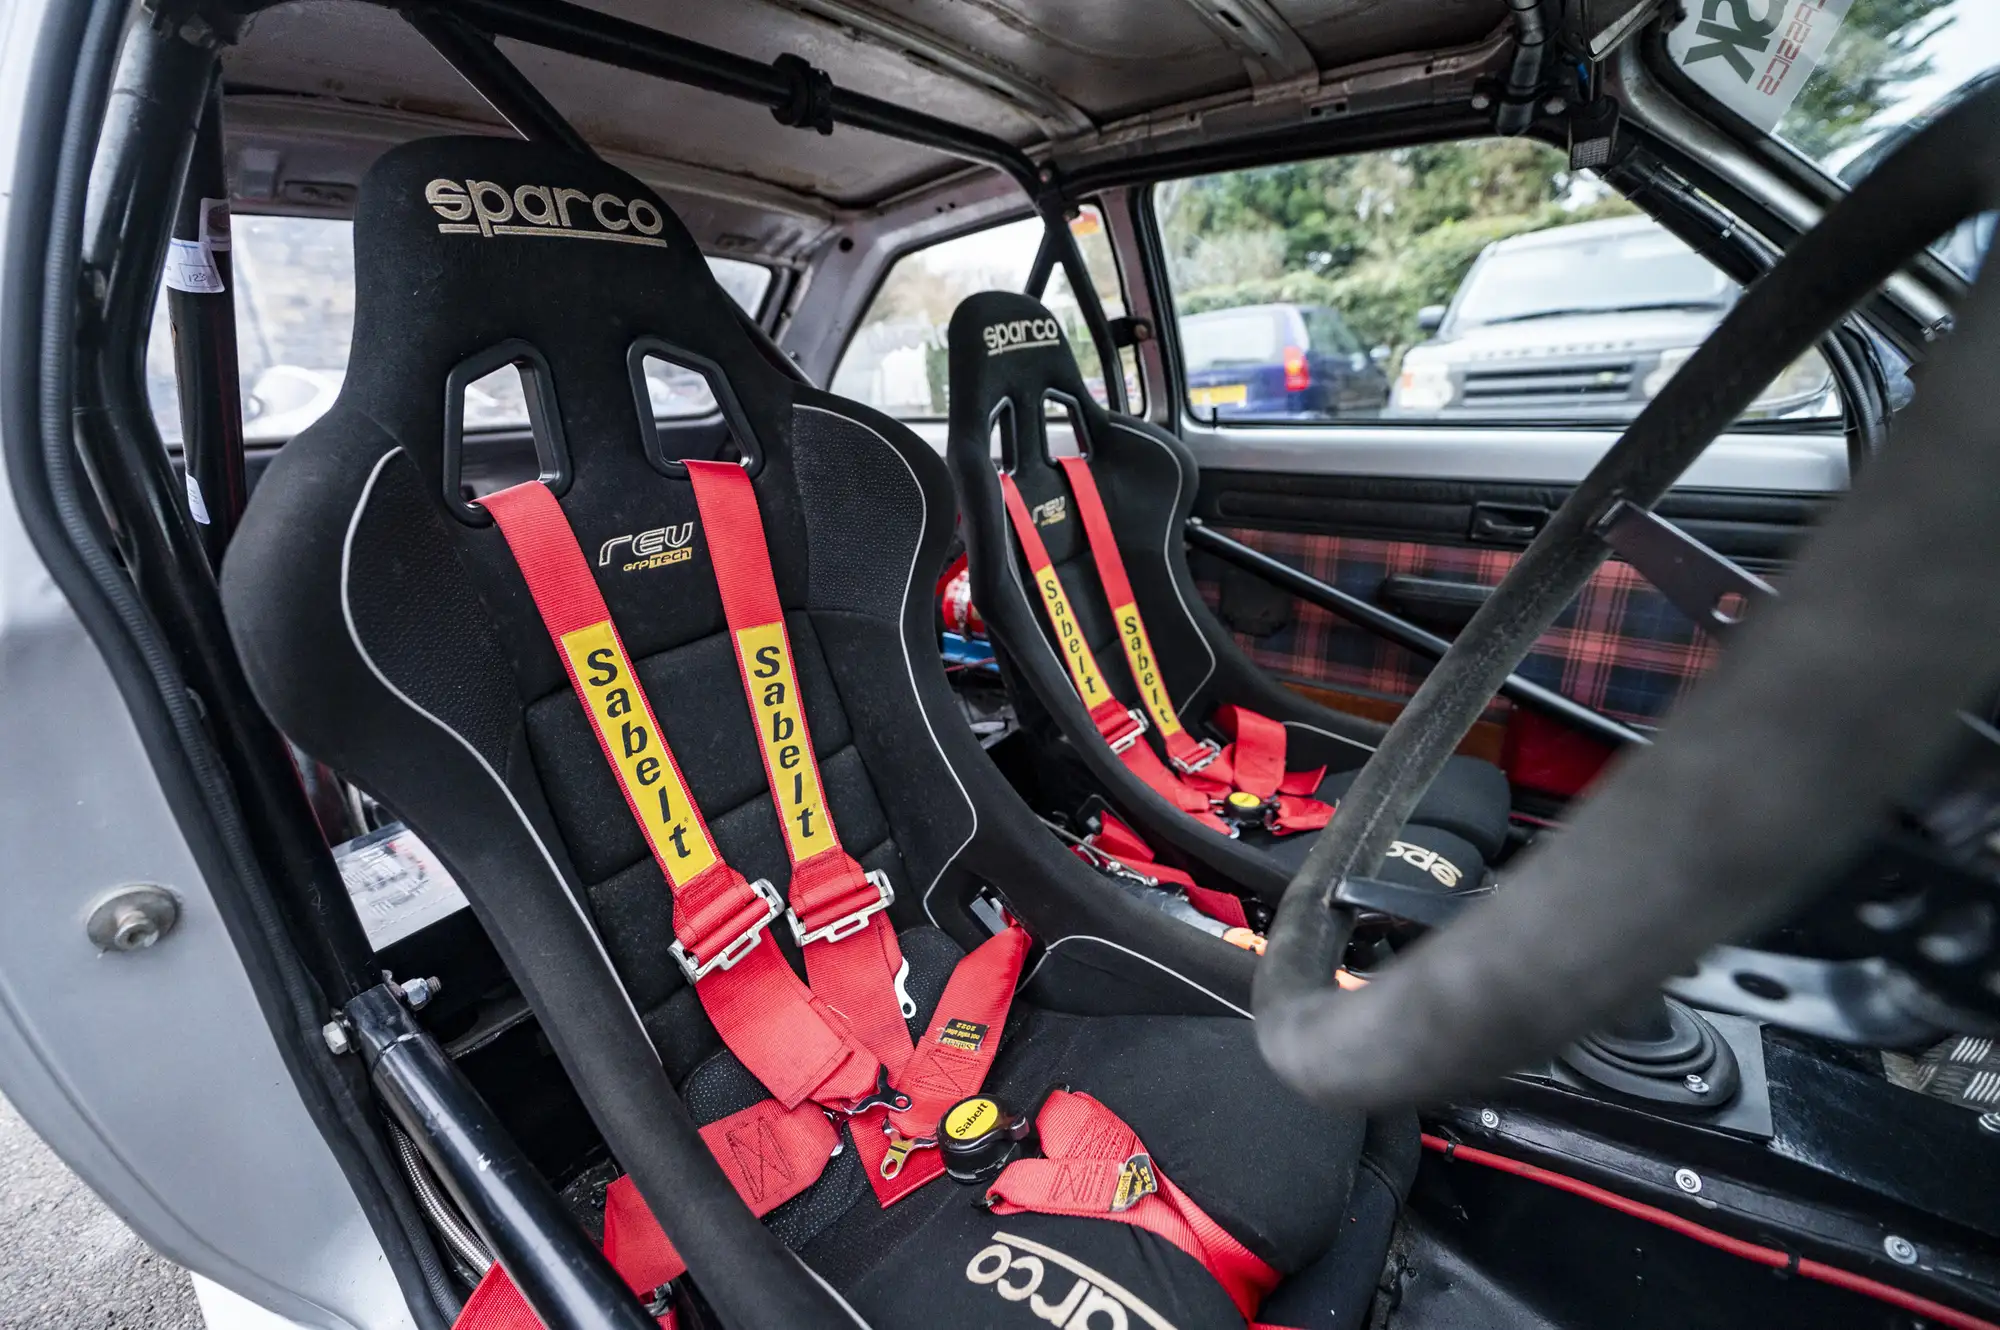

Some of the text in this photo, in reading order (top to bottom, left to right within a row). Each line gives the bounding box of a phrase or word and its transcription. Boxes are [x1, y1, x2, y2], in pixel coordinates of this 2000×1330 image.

[425, 178, 665, 240] sparco
[983, 318, 1059, 355] sparco
[1045, 580, 1097, 693] Sabelt
[1124, 616, 1170, 723] Sabelt
[587, 648, 691, 858] Sabelt
[753, 646, 815, 838] Sabelt
[956, 1022, 977, 1031] 2022
[955, 1102, 988, 1136] Sabelt
